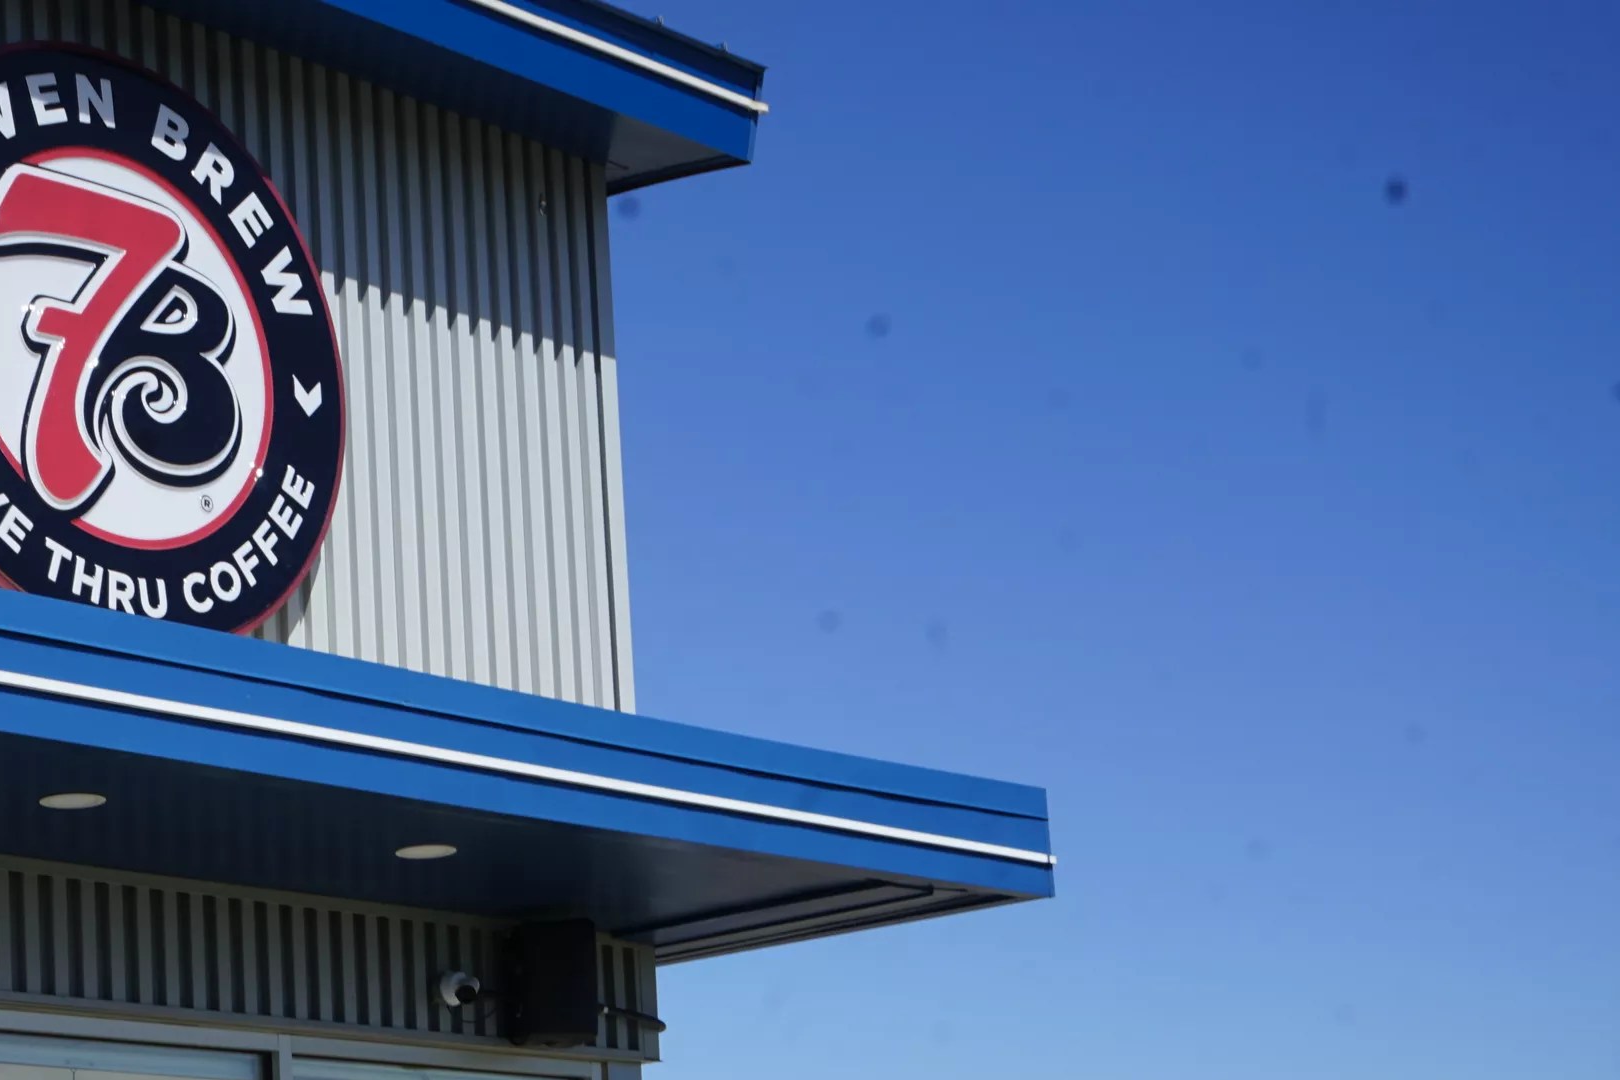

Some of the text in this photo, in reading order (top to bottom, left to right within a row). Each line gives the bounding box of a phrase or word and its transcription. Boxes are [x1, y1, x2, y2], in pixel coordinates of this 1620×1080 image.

[150, 103, 314, 316] BREW
[44, 536, 168, 619] THRU
[182, 464, 316, 613] COFFEE
